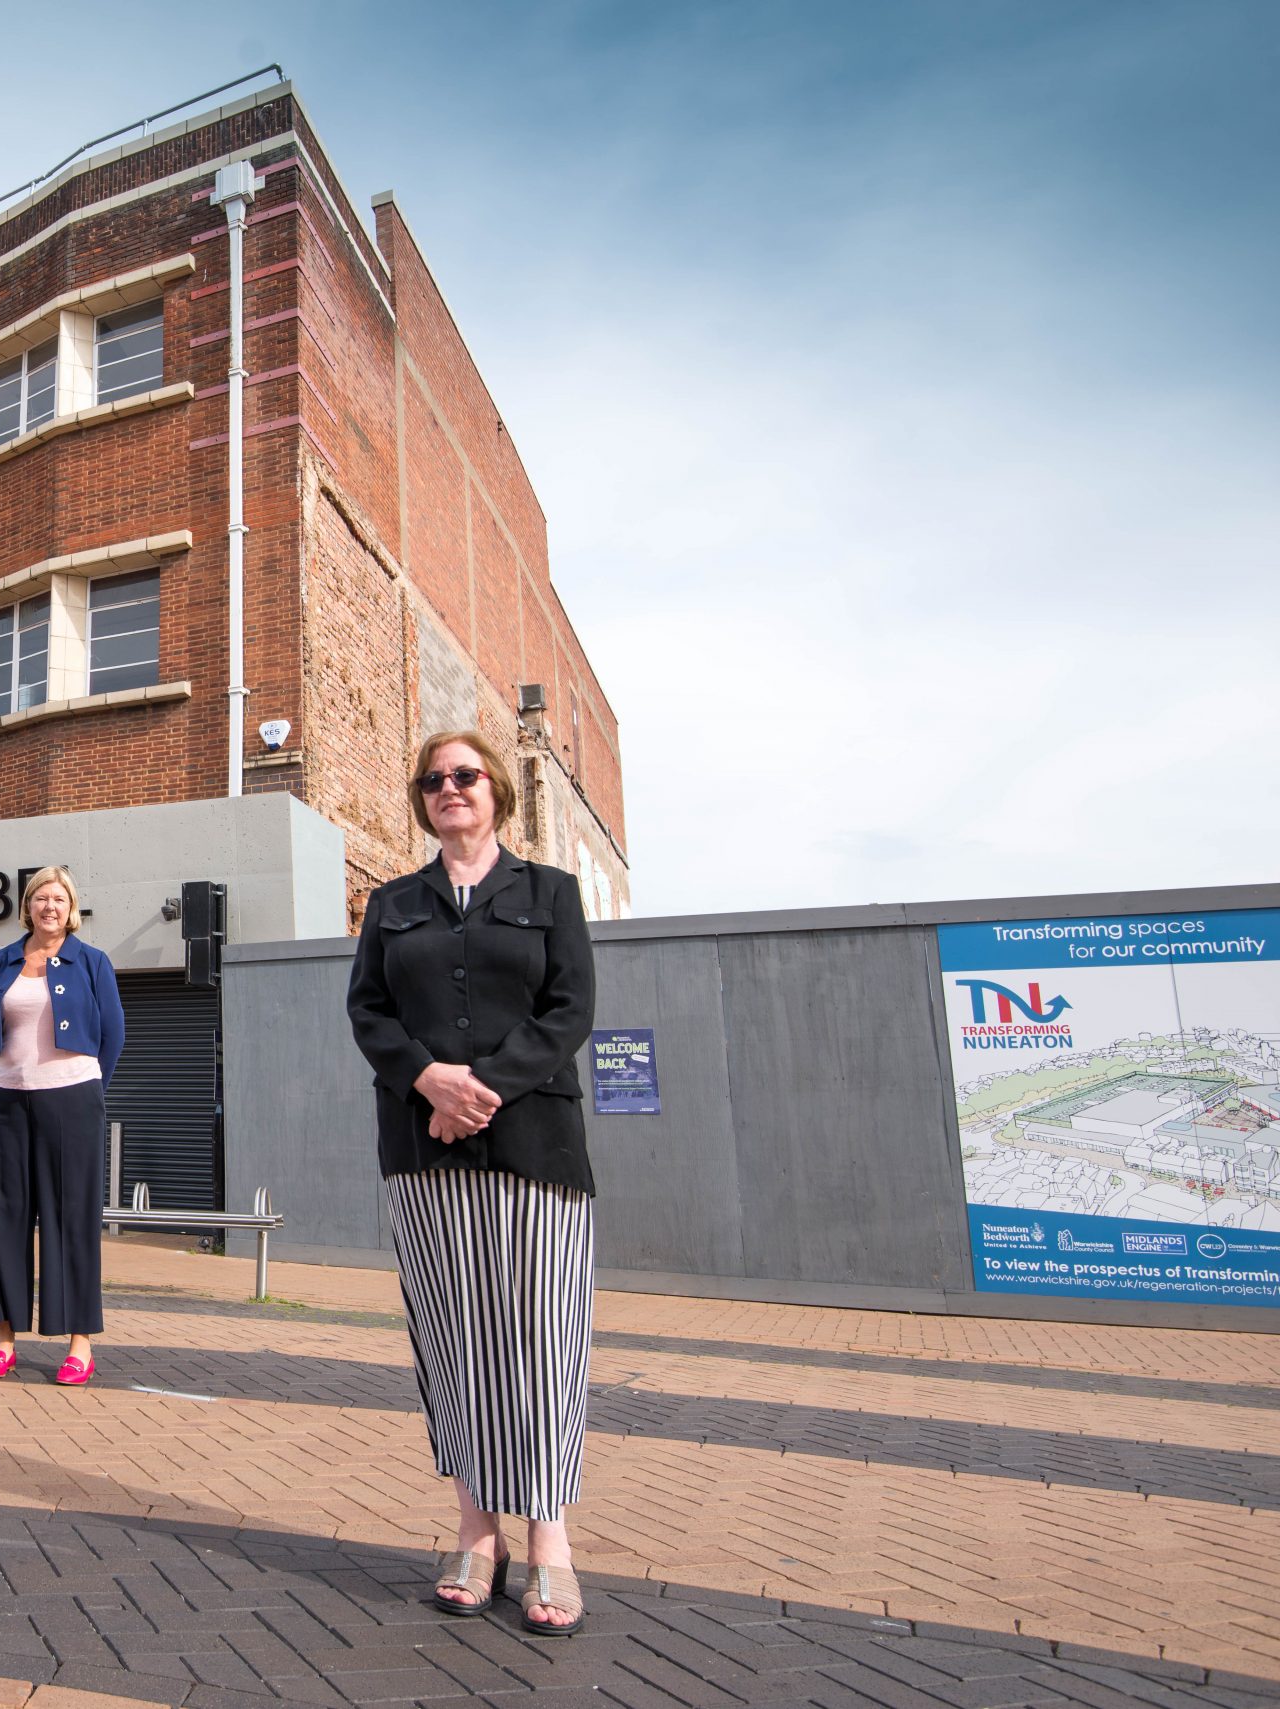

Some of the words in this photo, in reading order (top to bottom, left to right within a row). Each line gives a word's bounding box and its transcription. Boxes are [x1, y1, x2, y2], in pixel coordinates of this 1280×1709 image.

[264, 728, 280, 736] KES
[993, 922, 1123, 942] Transforming
[1128, 920, 1206, 938] spaces
[1069, 943, 1096, 959] for
[1102, 944, 1137, 958] our
[1141, 936, 1266, 956] community
[961, 1024, 1071, 1036] TRANSFORMING
[963, 1034, 1073, 1050] NUNEATON
[595, 1042, 650, 1055] WELCOME
[596, 1058, 627, 1070] BACK
[982, 1223, 1029, 1234] Nuneaton
[983, 1232, 1030, 1242] Bedworth
[1125, 1235, 1183, 1245] MIDLANDS
[1126, 1243, 1162, 1252] ENGINE
[984, 1257, 1001, 1270] To
[1005, 1259, 1040, 1271] view
[1044, 1260, 1069, 1273] the
[1073, 1264, 1161, 1277] prospectus
[1165, 1265, 1181, 1278] of
